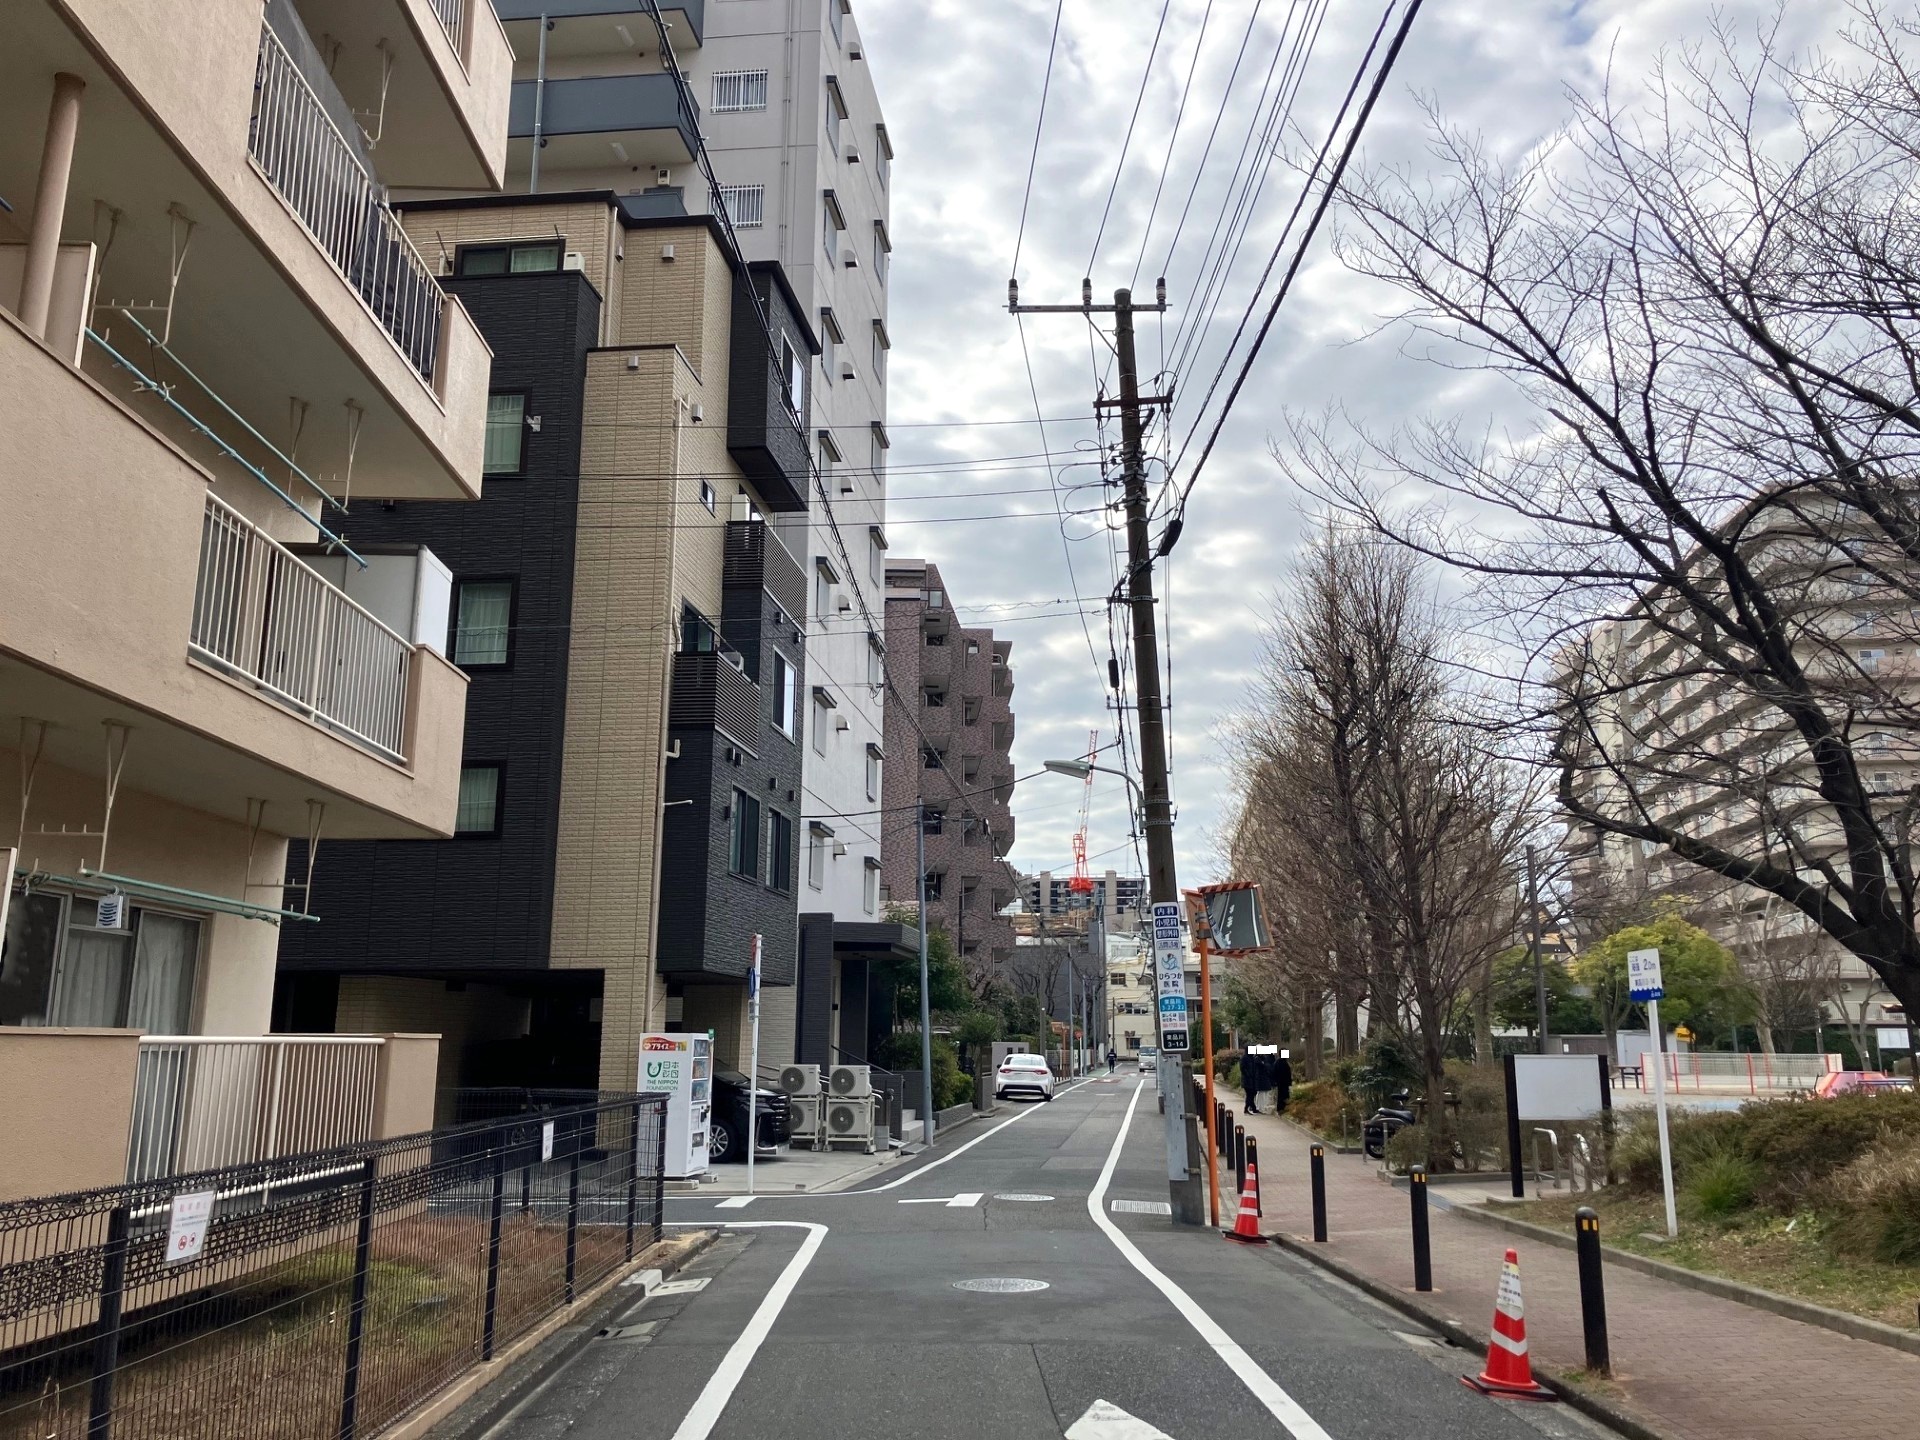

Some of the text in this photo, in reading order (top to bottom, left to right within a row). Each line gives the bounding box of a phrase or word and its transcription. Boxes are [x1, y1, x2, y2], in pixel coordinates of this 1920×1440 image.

[1157, 907, 1175, 915] 内科
[1156, 918, 1177, 927] 小児科
[1156, 929, 1178, 939] 整形外科
[1158, 972, 1183, 980] ひらつか
[662, 1061, 679, 1069] 日本
